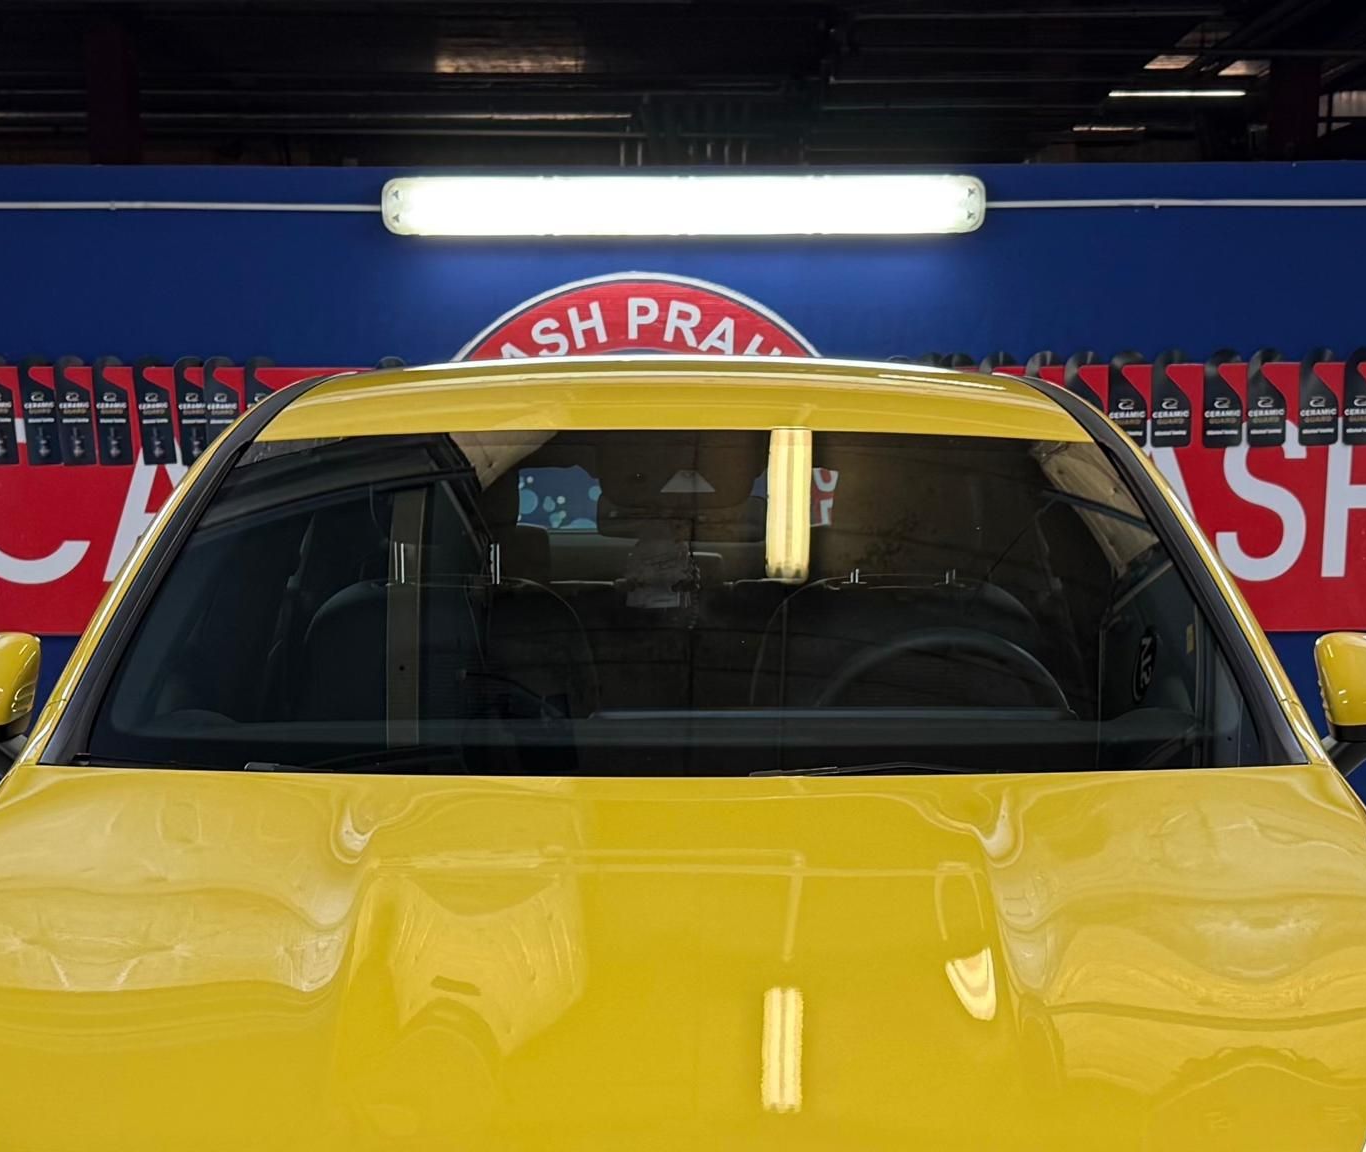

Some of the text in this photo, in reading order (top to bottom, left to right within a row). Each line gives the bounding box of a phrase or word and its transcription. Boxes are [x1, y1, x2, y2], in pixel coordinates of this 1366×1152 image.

[1109, 410, 1146, 419] CERAMIC
[1152, 410, 1189, 418] CERAMIC
[1204, 409, 1241, 418] CERAMIC
[1248, 409, 1284, 417] CERAMIC
[1300, 408, 1337, 417] CERAMIC
